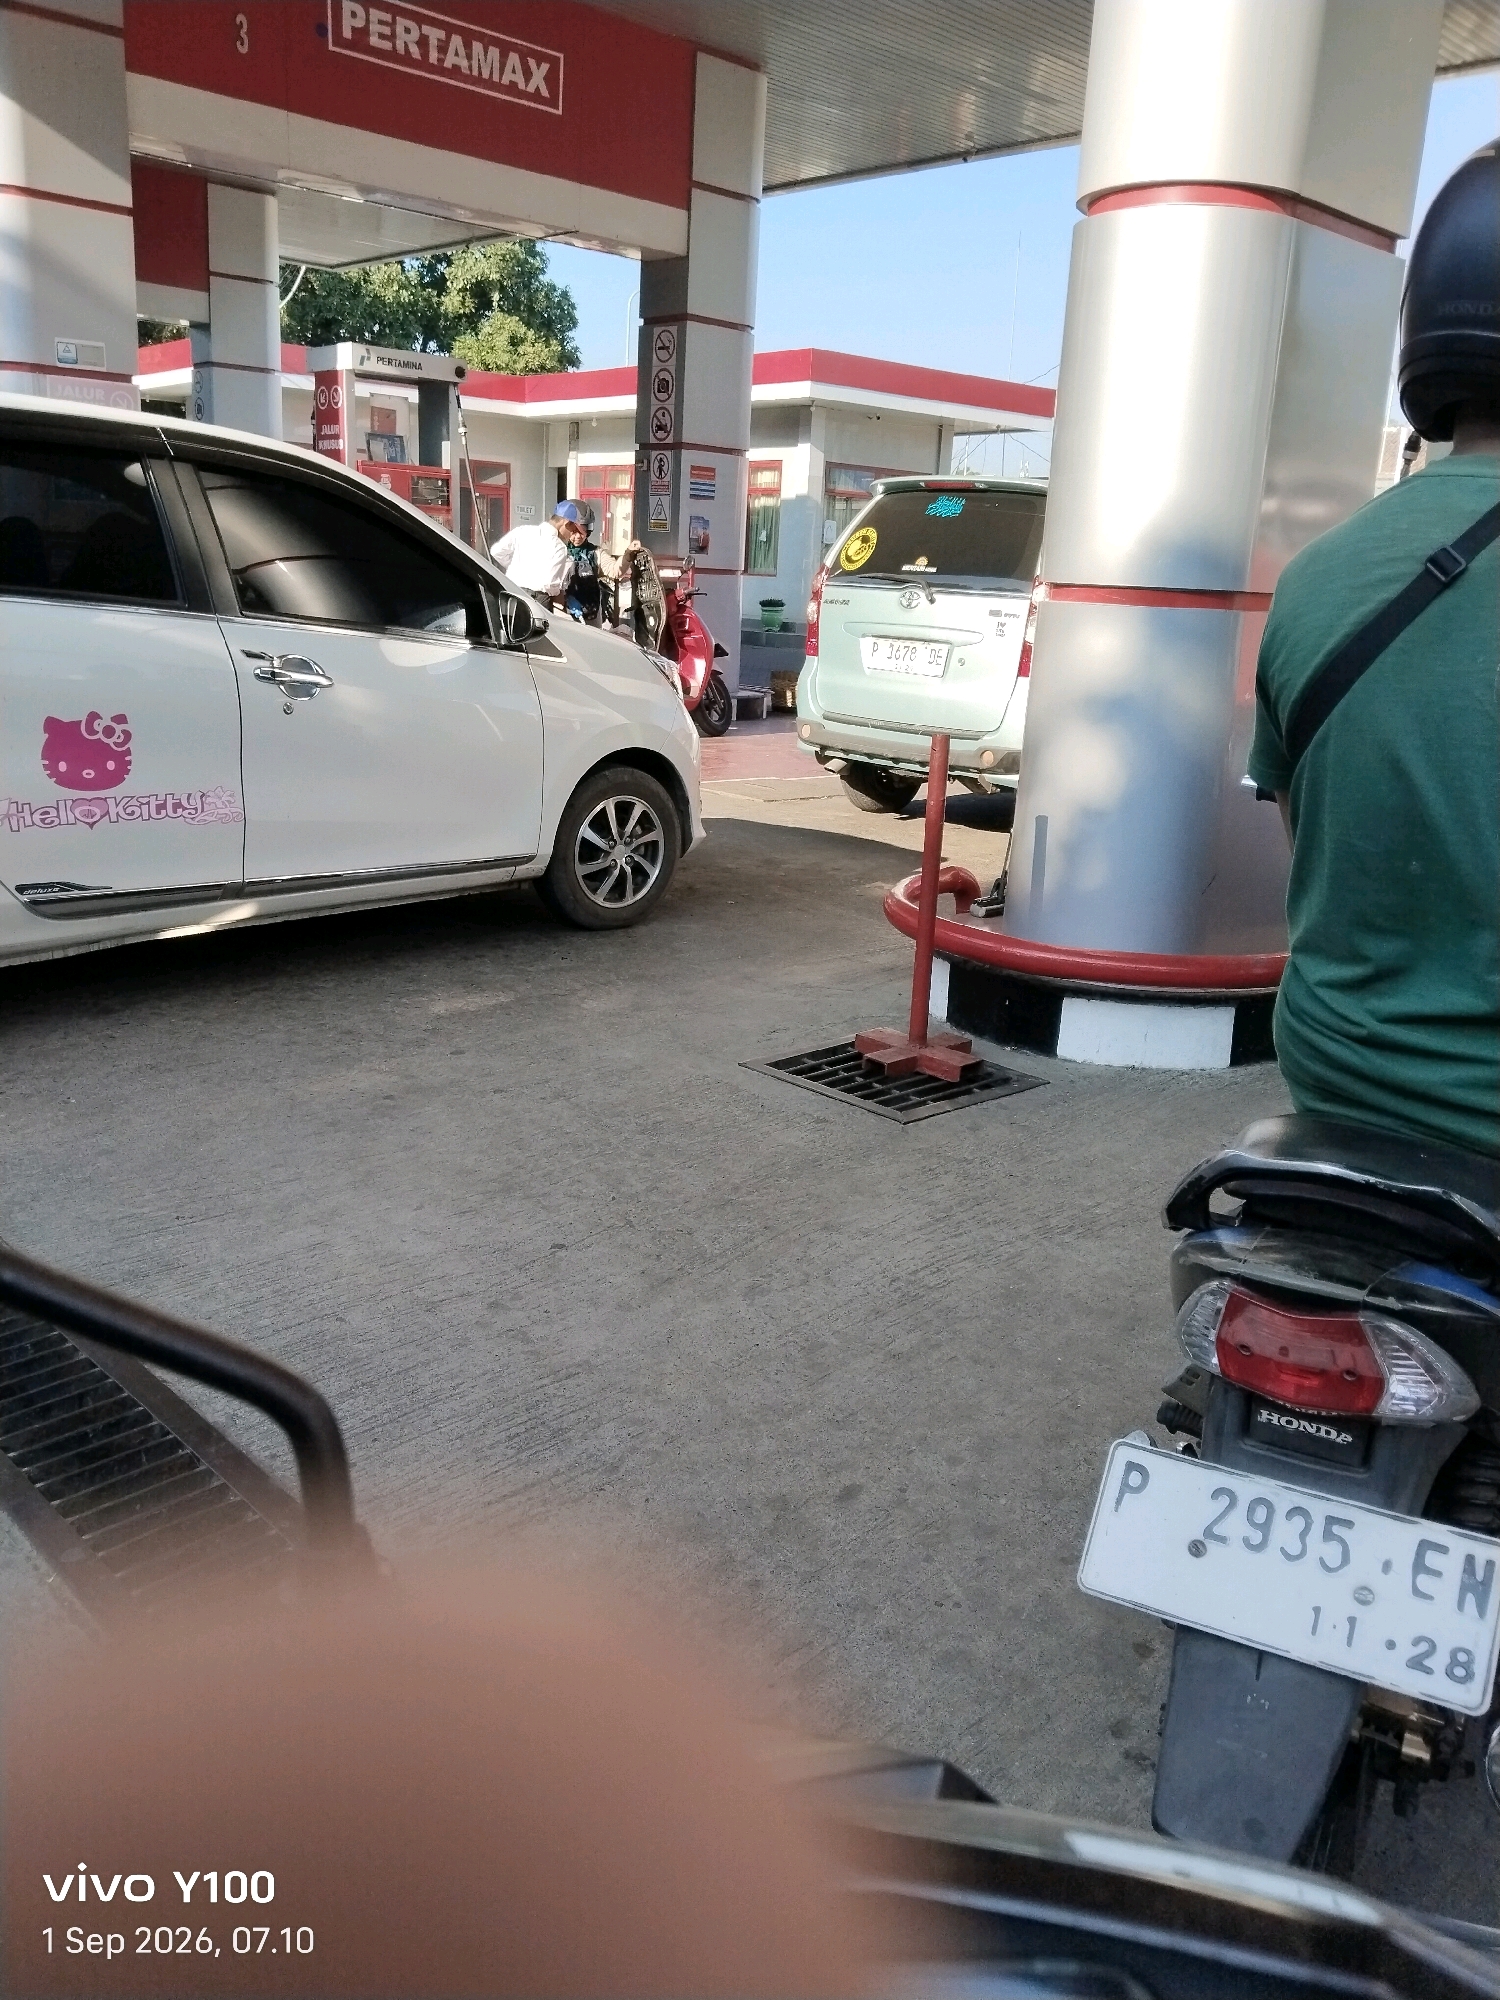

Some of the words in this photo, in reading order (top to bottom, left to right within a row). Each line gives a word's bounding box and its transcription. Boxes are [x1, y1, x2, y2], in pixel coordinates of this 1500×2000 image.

[235, 13, 249, 54] 3
[341, 0, 550, 98] PERTAMAX
[1437, 301, 1500, 316] HOND
[376, 356, 423, 371] PERTAMINA
[320, 424, 340, 435] JALUR
[871, 641, 879, 657] P
[6, 797, 102, 833] Hello
[107, 790, 205, 824] Kitty
[22, 887, 60, 895] deluxe
[1256, 1408, 1353, 1445] HONDA
[1115, 1459, 1150, 1513] P
[1202, 1486, 1355, 1574] 2935
[1411, 1537, 1497, 1620] EN
